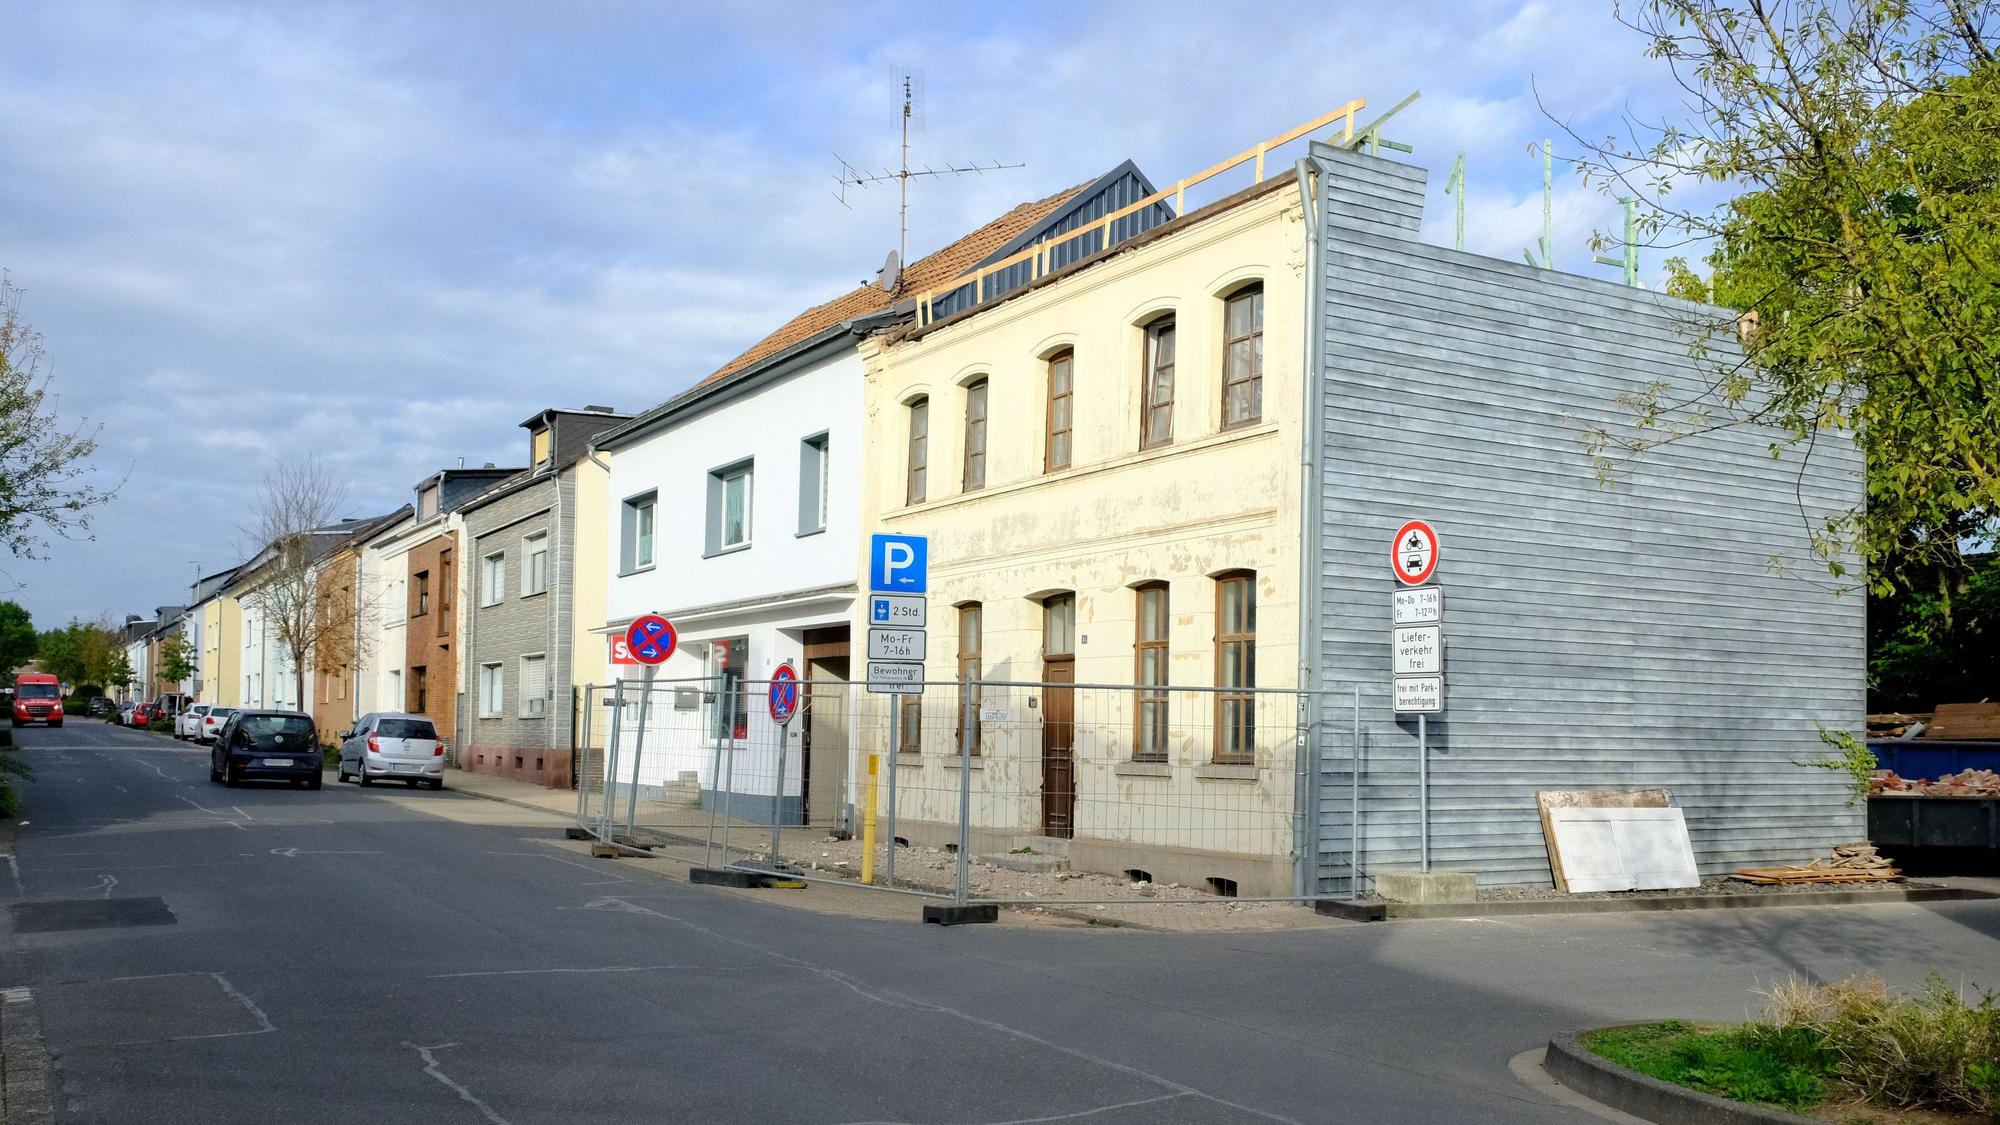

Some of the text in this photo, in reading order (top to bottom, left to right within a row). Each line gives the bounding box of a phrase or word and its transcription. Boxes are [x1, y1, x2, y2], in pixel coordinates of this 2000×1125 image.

[884, 541, 915, 585] P
[893, 606, 921, 617] 2 Std.
[1396, 609, 1403, 619] Fr
[880, 633, 914, 644] Mo-Fr
[1401, 632, 1431, 643] Liefer-
[1400, 645, 1433, 656] verkehr
[1409, 658, 1425, 669] frei
[873, 666, 918, 676] Bewohner
[1397, 682, 1438, 693] frei mit Park-
[1399, 696, 1436, 708] berechtigung
